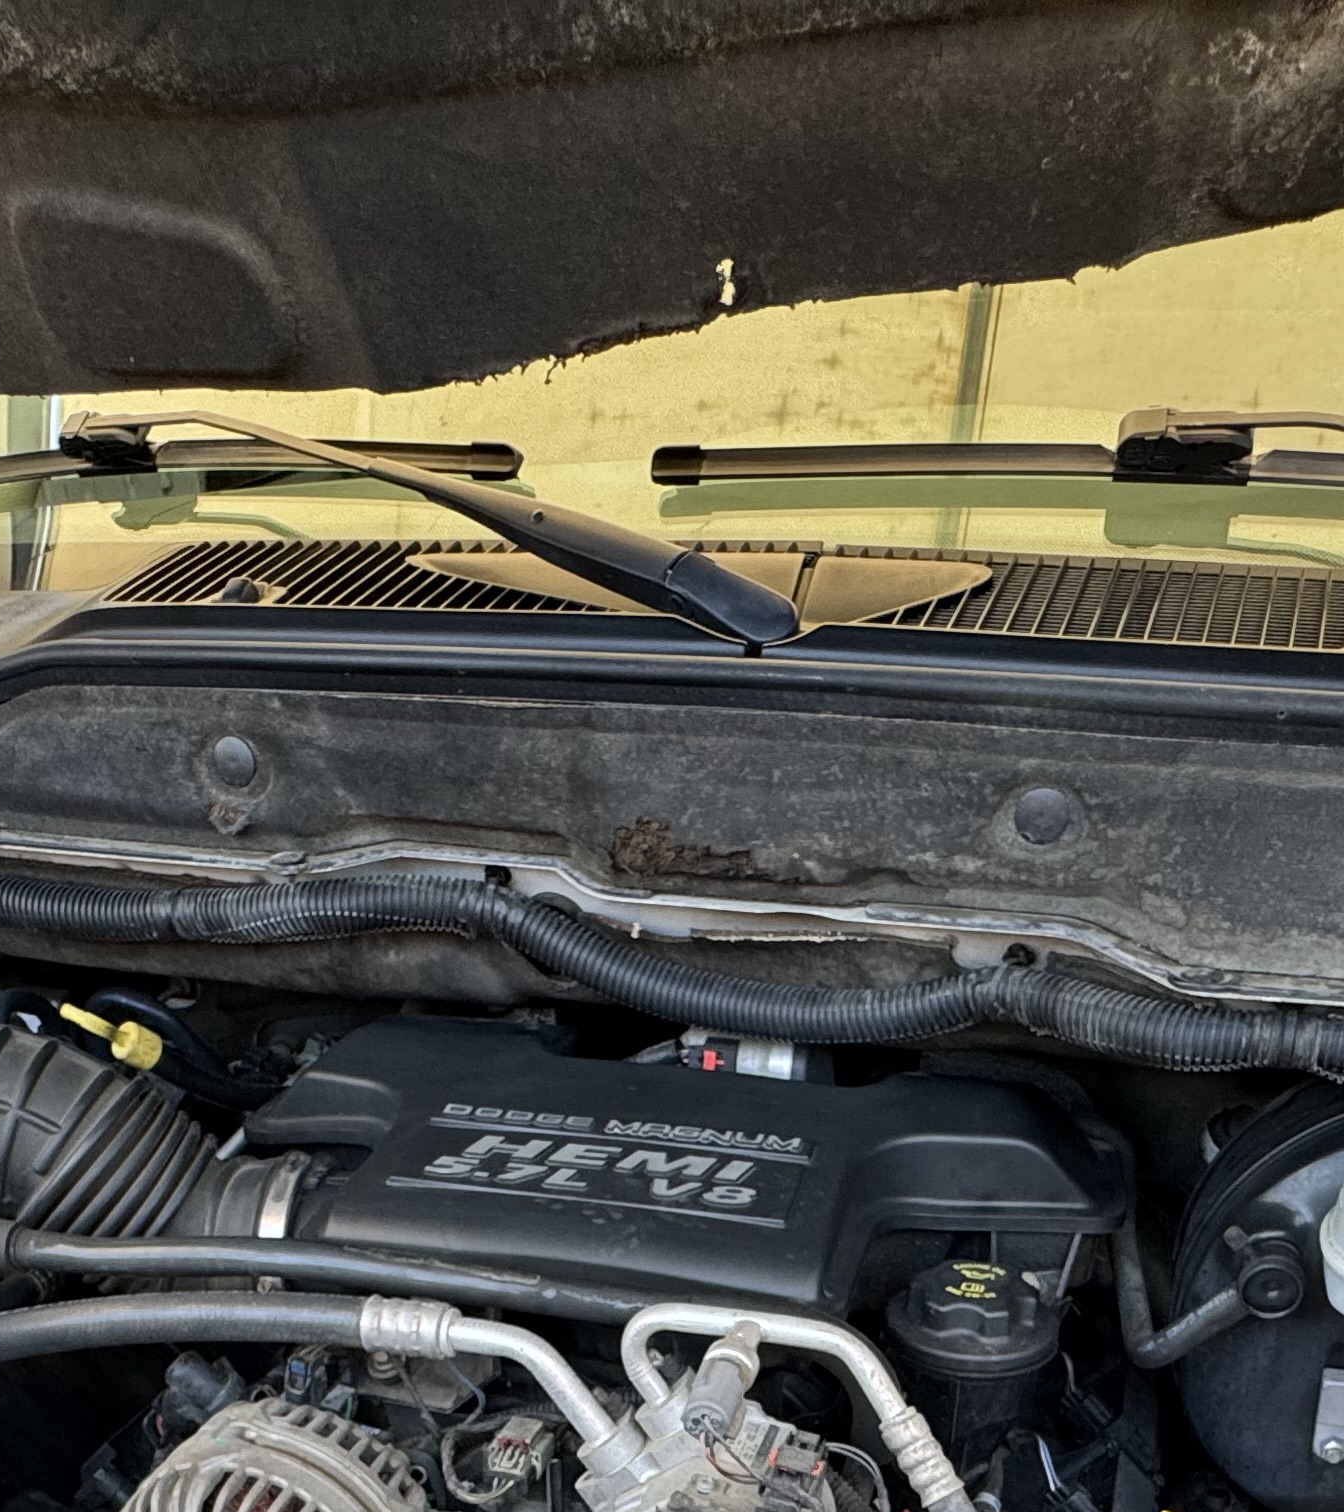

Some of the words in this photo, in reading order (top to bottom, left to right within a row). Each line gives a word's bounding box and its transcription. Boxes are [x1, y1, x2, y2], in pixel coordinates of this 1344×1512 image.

[442, 1102, 596, 1131] DODGE
[604, 1118, 807, 1156] MAGNUM
[423, 1155, 589, 1192] 5.7L
[649, 1177, 757, 1208] V8
[461, 1134, 755, 1185] HEMI
